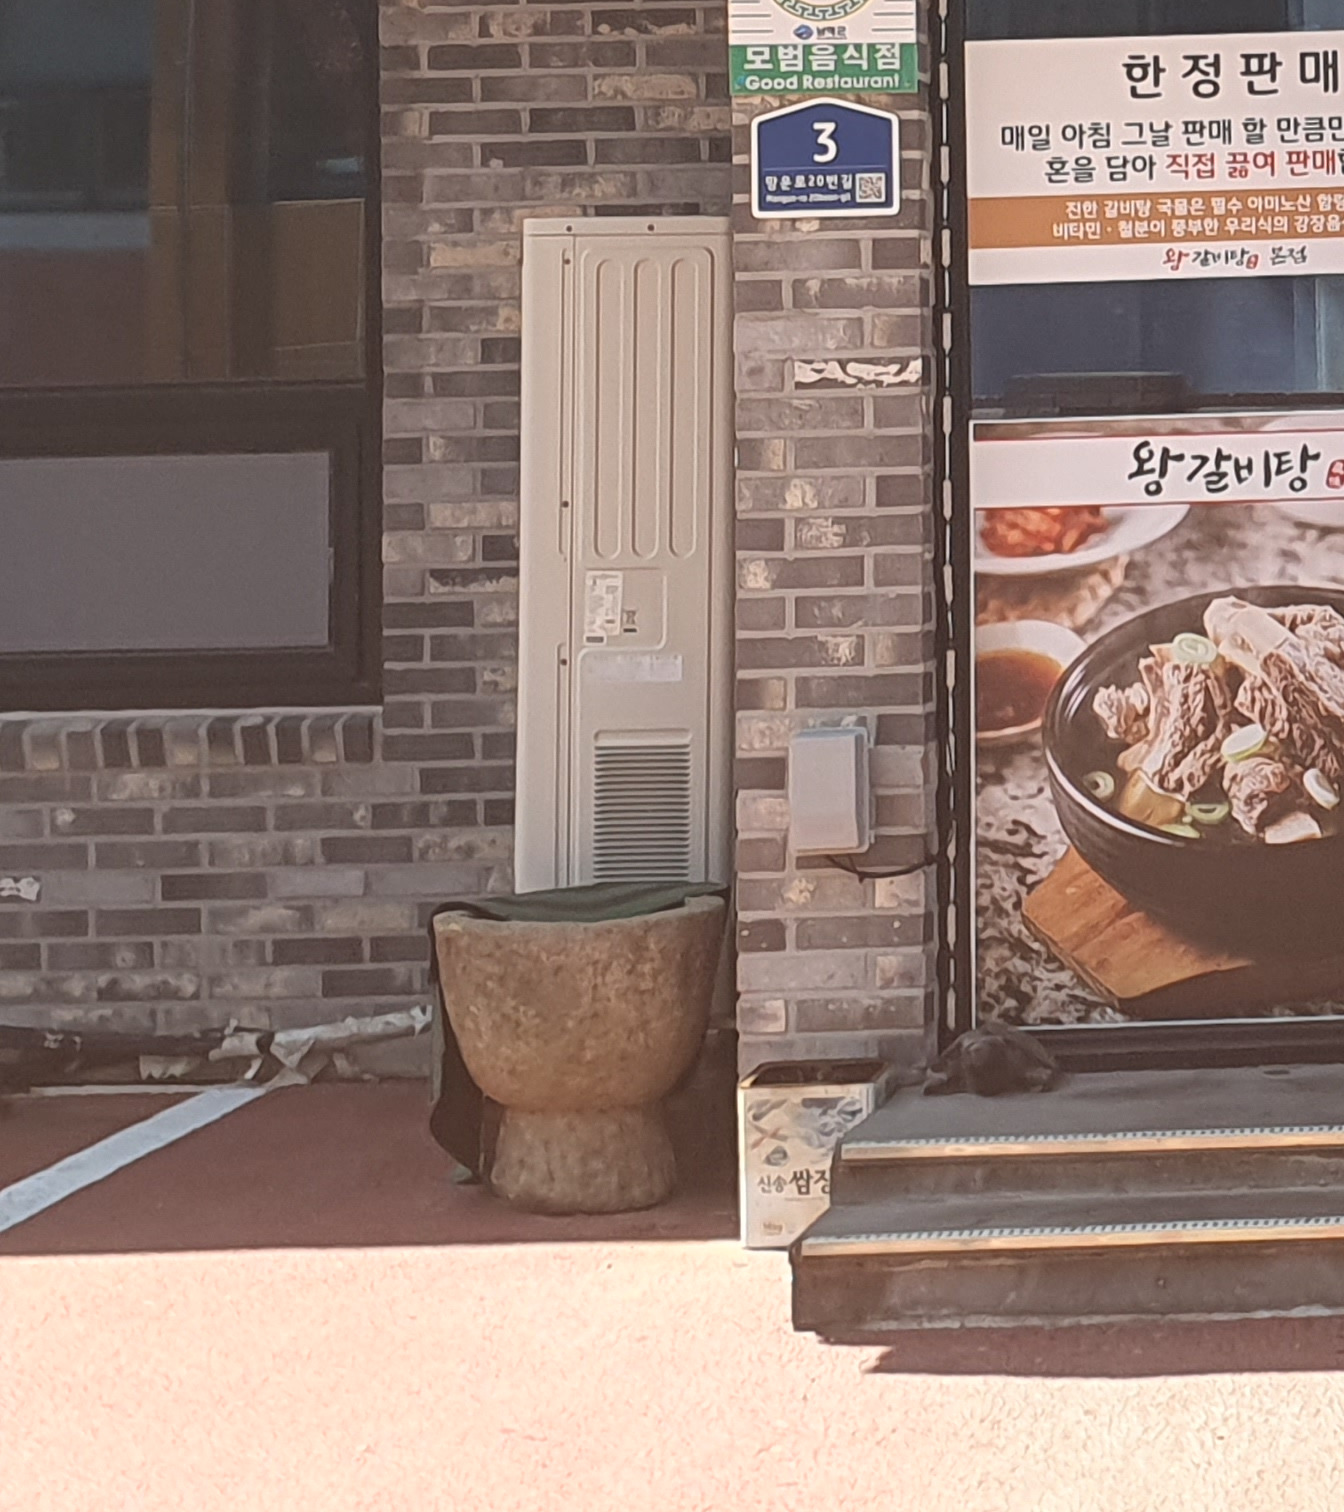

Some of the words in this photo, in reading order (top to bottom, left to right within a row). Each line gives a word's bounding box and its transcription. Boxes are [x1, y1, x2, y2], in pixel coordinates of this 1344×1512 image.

[743, 44, 901, 71] 모범음식점
[745, 74, 798, 90] Good
[803, 73, 899, 90] Restaurant
[1122, 50, 1340, 99] 한정판매
[812, 122, 838, 162] 3
[1001, 124, 1051, 150] 매일
[1061, 122, 1111, 148] 아침
[1121, 121, 1172, 146] 그날
[1182, 119, 1231, 145] 판매
[1242, 118, 1267, 144] 할
[1045, 157, 1096, 183] 혼을
[1106, 155, 1155, 181] 담아
[1165, 153, 1215, 179] 직접
[1226, 151, 1276, 178] 끓여
[1066, 201, 1097, 219] 진한
[1104, 199, 1151, 218] 갈비탕
[1157, 198, 1204, 216] 국물은
[1211, 196, 1241, 215] 필수
[1248, 194, 1311, 212] 아미노산
[1053, 221, 1100, 239] 비타민
[1118, 219, 1165, 237] 철분이
[1171, 218, 1218, 236] 풍부한
[1225, 216, 1288, 234] 우리식의
